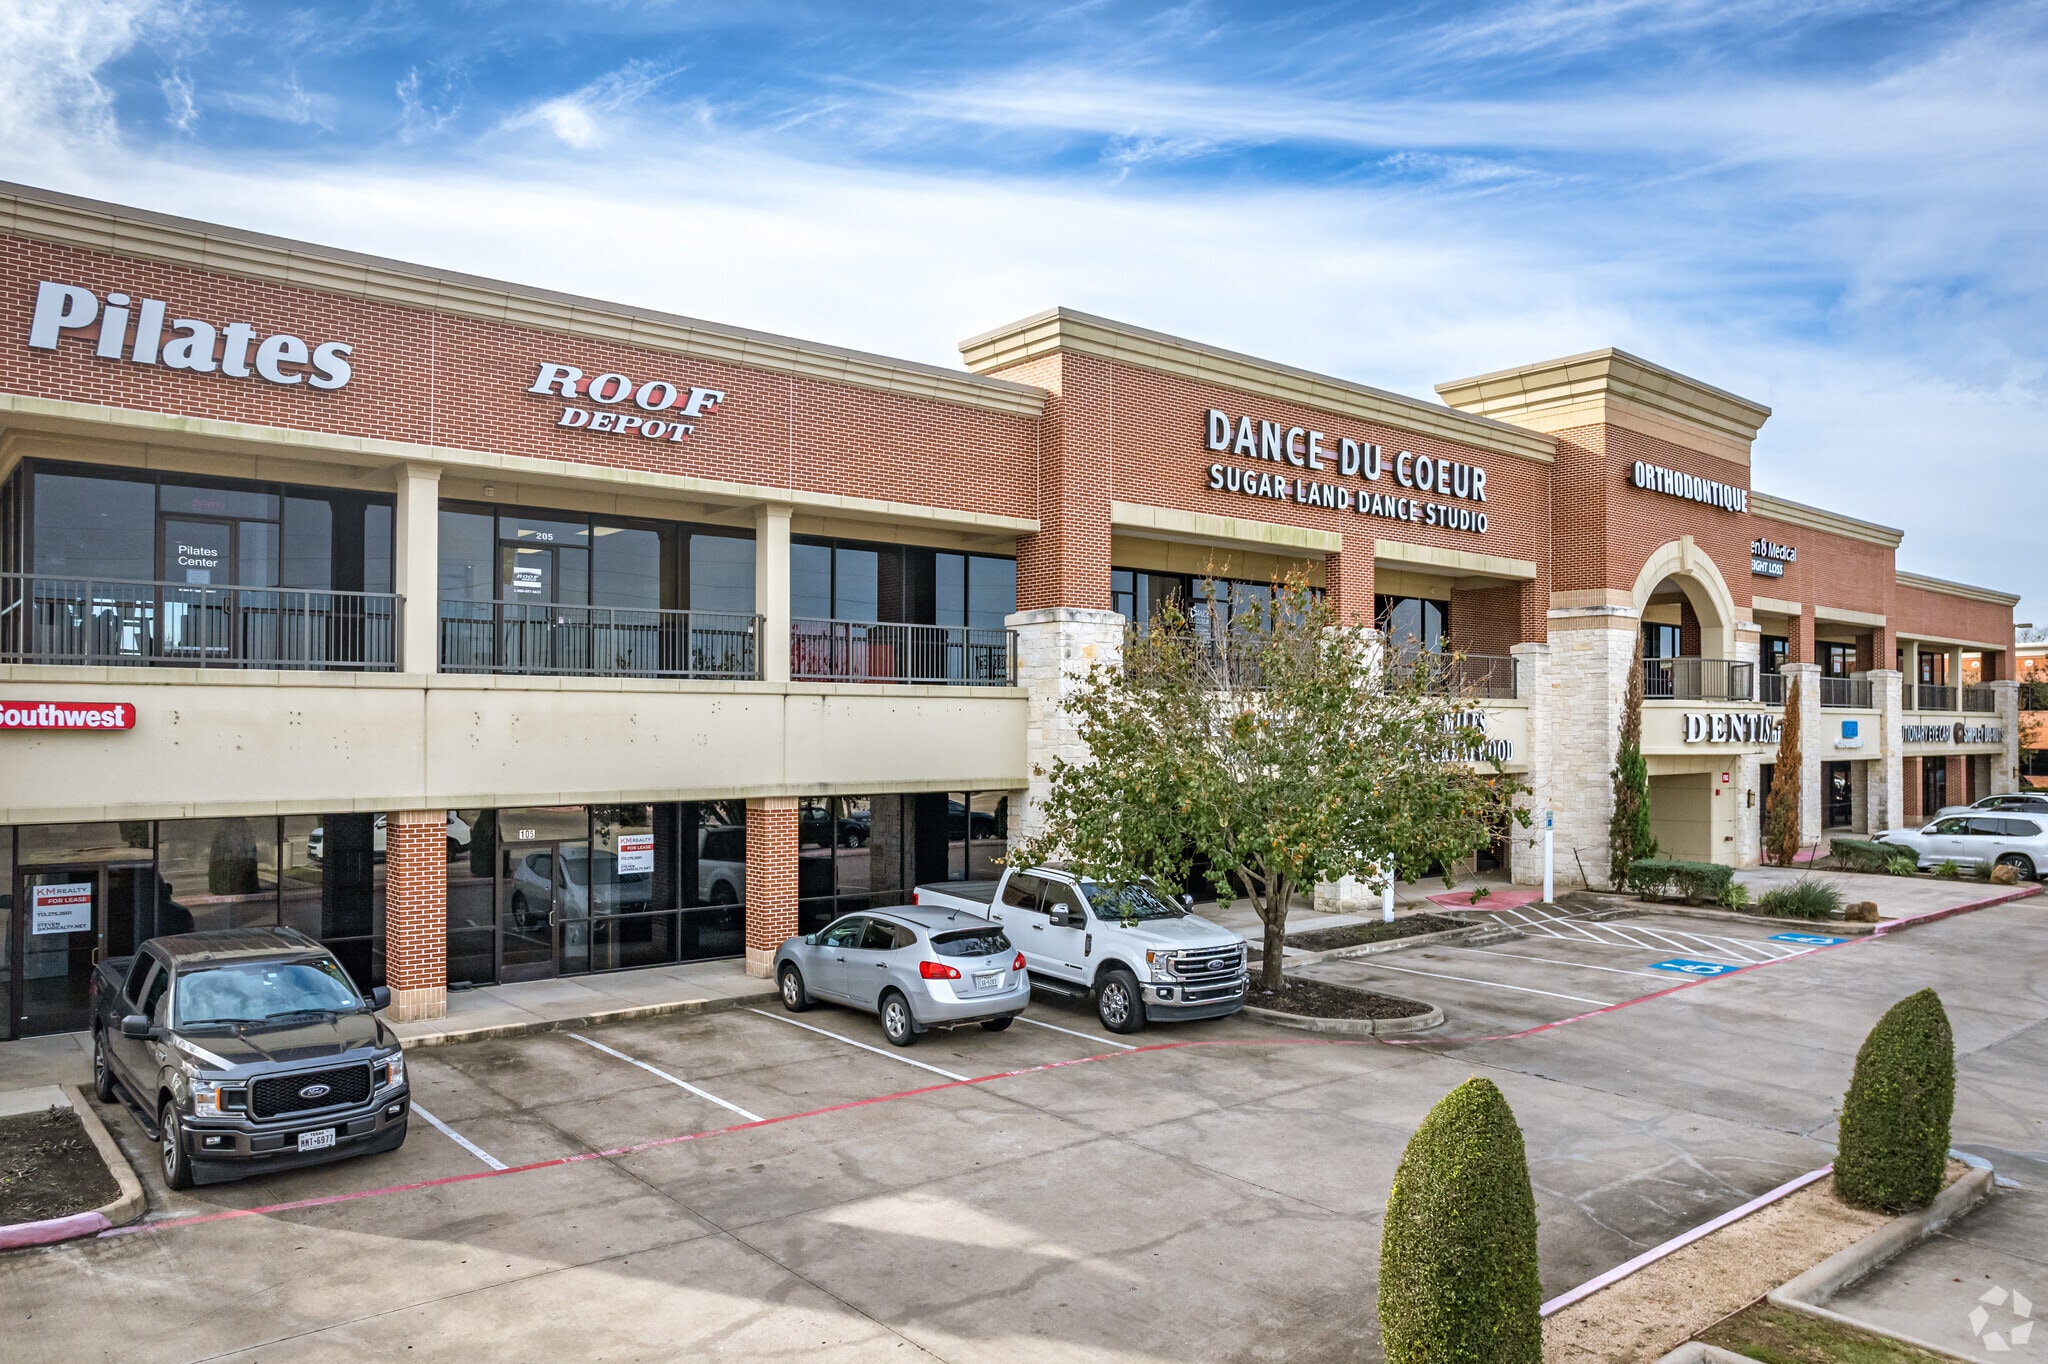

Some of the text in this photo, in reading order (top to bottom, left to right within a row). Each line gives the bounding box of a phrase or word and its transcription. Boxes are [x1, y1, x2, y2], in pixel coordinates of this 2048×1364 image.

[29, 280, 354, 390] Pilates
[527, 361, 726, 418] ROOF
[557, 407, 695, 443] DEPOT
[1206, 408, 1487, 501] DANCE DU COEUR
[1632, 460, 1748, 513] ORTHODONTIQUE
[1208, 463, 1488, 534] SUGAR LAND DANCE STUDIO
[536, 532, 554, 541] 205
[178, 545, 218, 557] Pilates
[178, 556, 218, 568] Center
[1768, 542, 1797, 562] Medical
[1769, 563, 1783, 575] LOSS
[0, 703, 125, 727] outhwest
[520, 829, 535, 839] 105
[37, 888, 56, 896] KM
